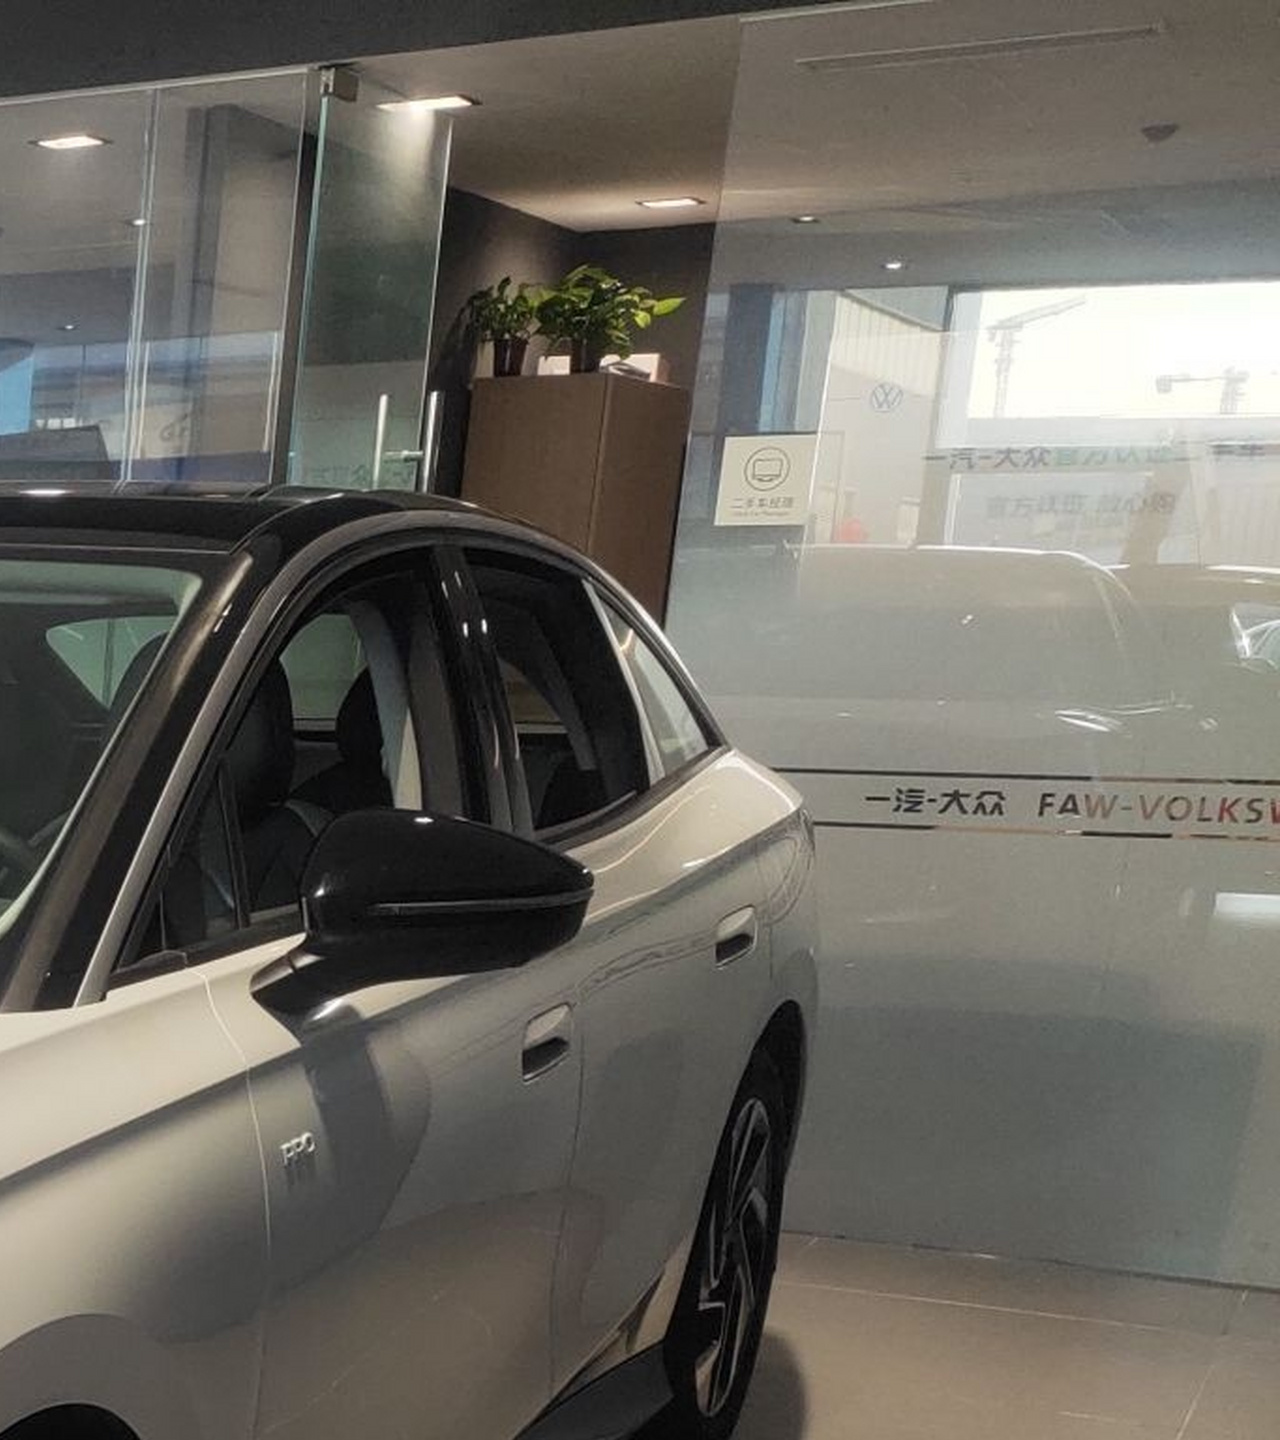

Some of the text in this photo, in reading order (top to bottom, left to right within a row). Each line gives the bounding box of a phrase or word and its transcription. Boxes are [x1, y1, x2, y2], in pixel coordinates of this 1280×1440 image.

[865, 787, 1280, 826] 一汽-大众 FAW-VOLKS
